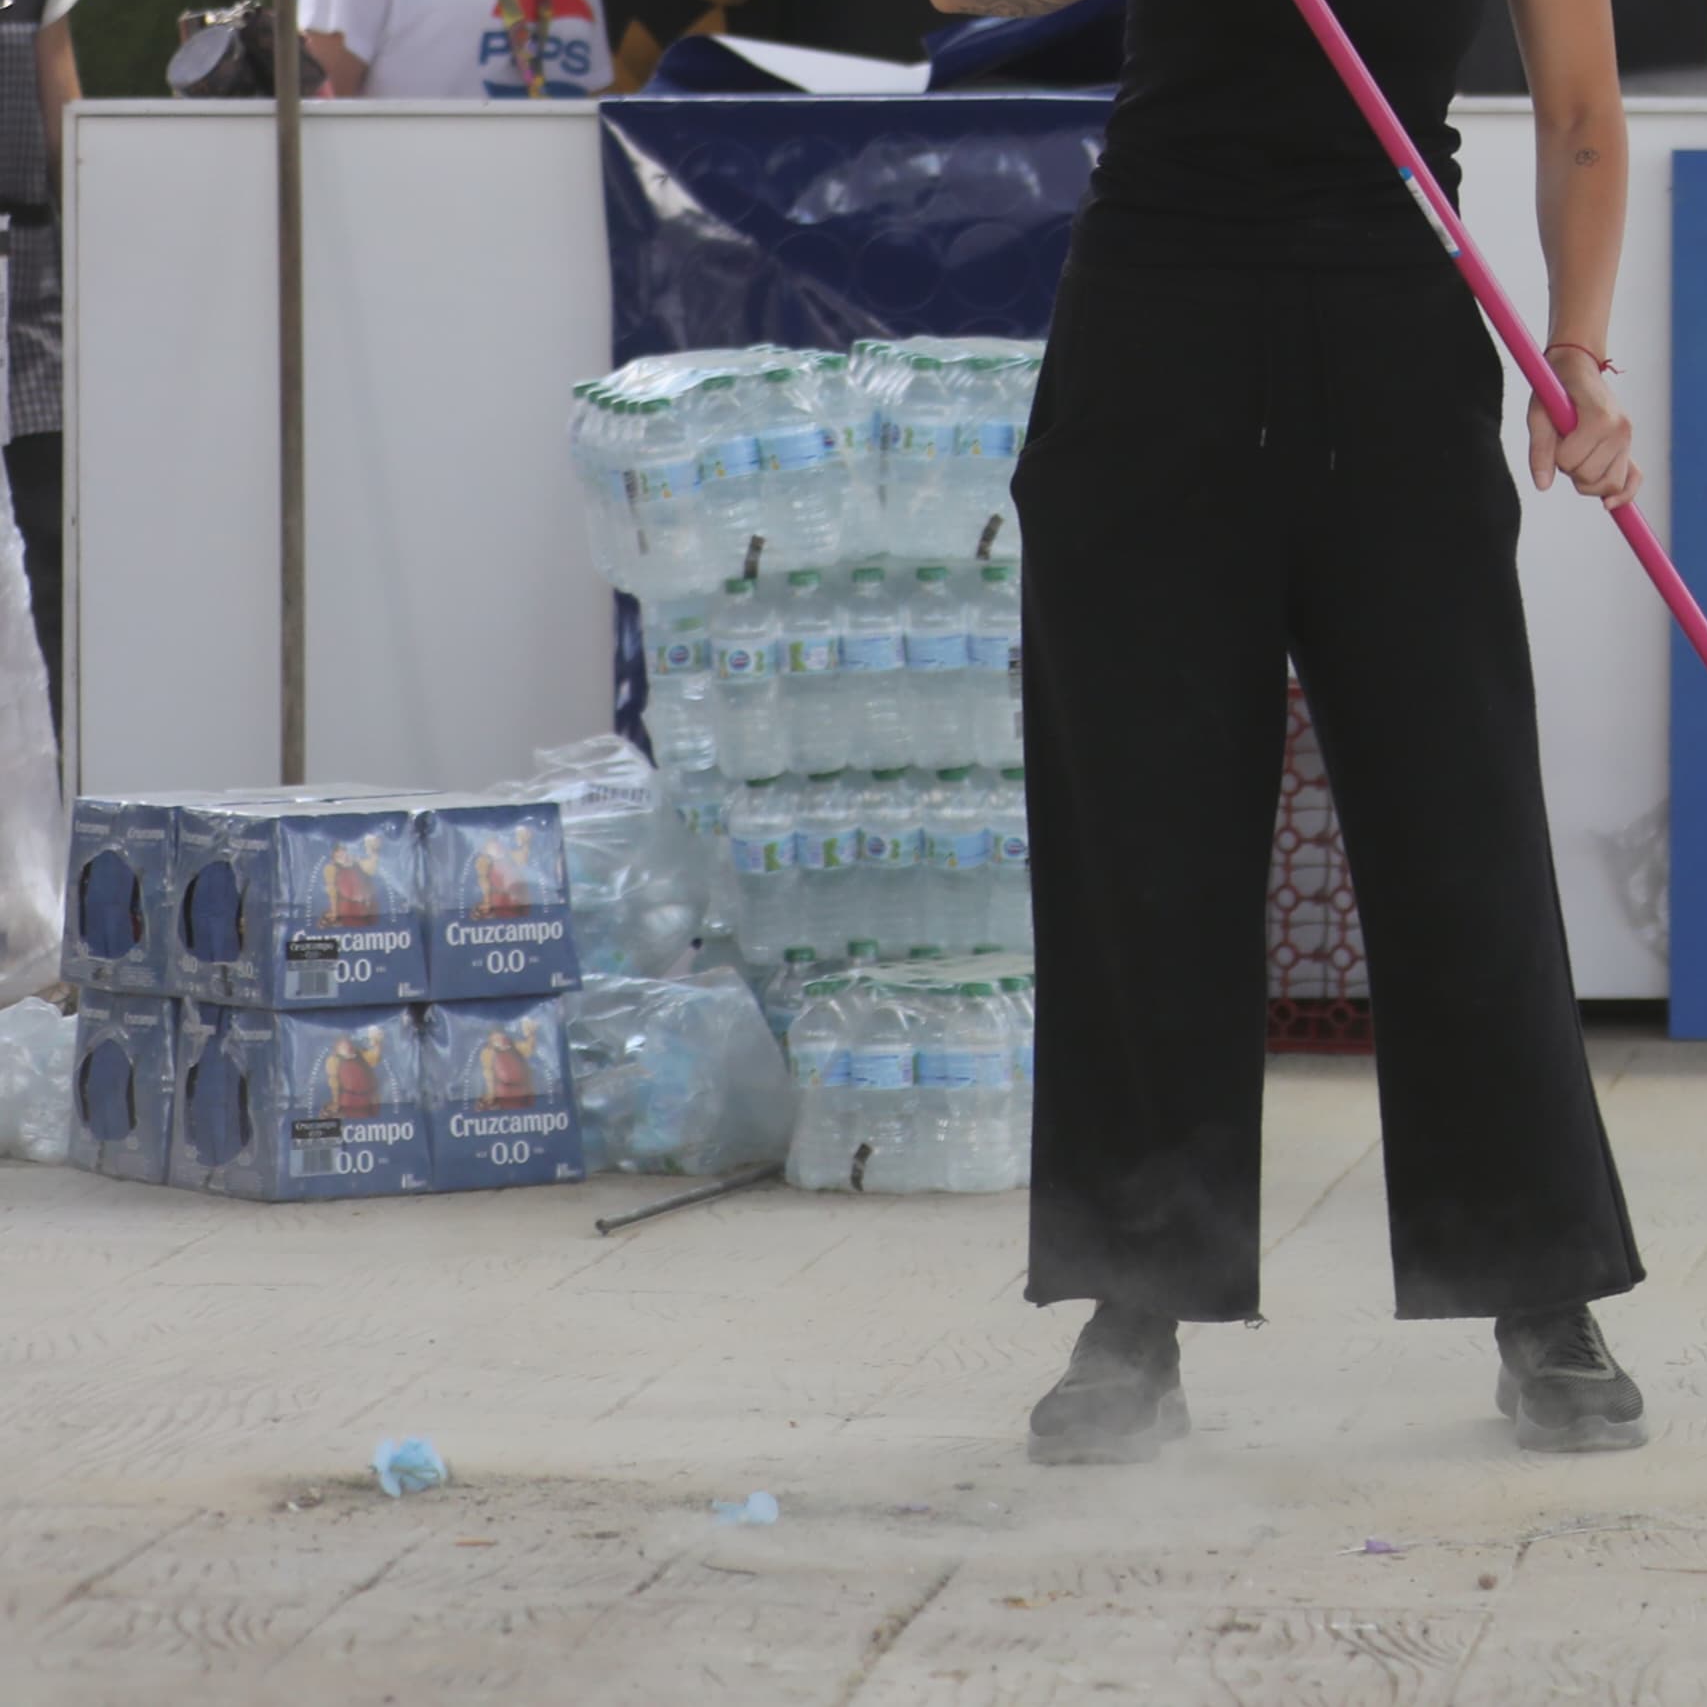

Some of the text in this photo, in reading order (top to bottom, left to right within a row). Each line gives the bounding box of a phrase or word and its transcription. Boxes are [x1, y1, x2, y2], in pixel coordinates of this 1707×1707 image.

[479, 29, 592, 77] PPS
[446, 921, 564, 949] Cruzcampo
[334, 958, 372, 983] 0.0
[486, 949, 526, 975] 0.0
[450, 1112, 569, 1139] Cruzcampo
[335, 1150, 374, 1174] 0.0
[490, 1142, 530, 1165] 0.0
